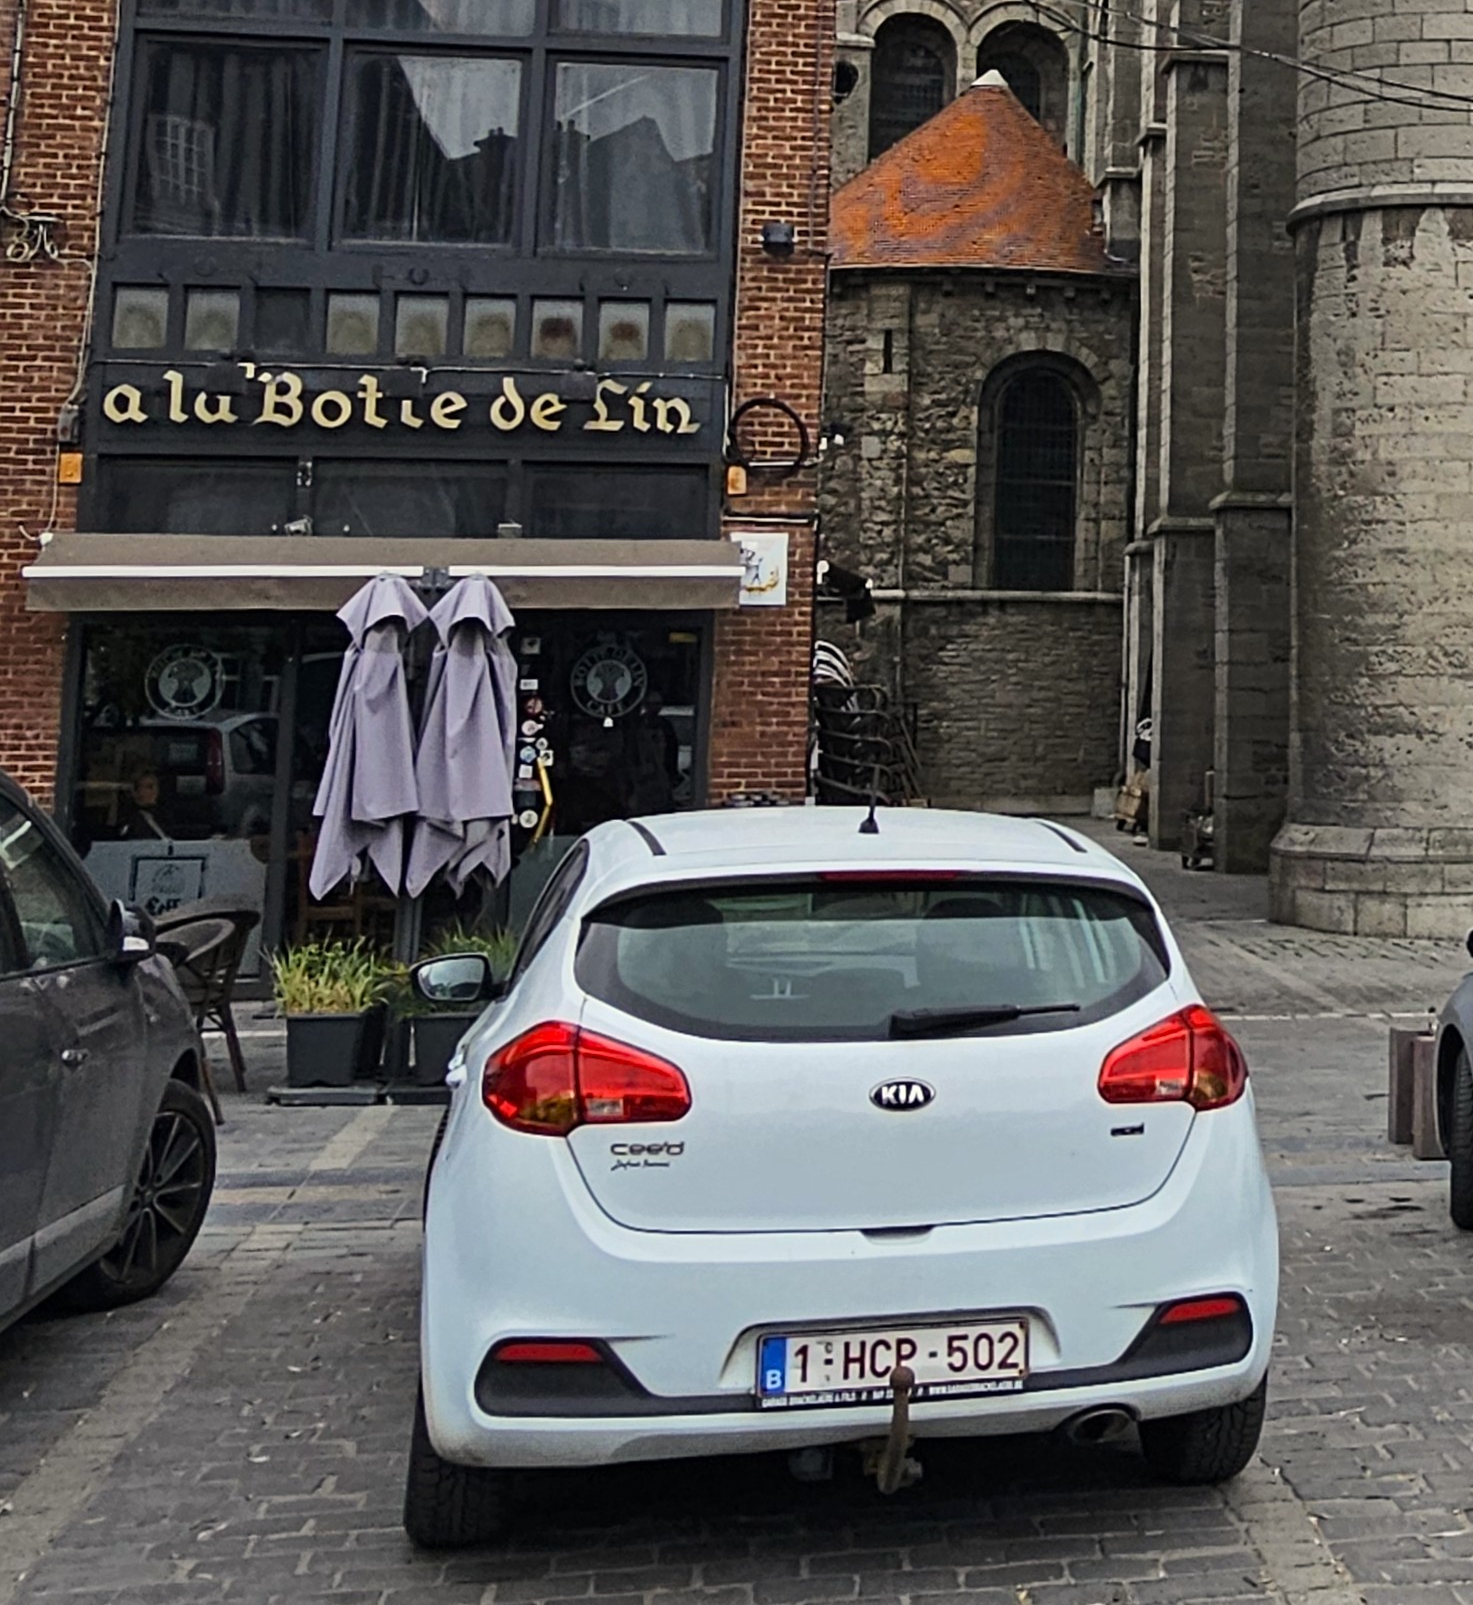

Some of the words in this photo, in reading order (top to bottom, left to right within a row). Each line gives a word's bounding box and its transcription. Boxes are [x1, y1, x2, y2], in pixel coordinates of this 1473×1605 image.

[103, 383, 148, 424] a
[490, 376, 567, 431] de
[881, 1084, 925, 1105] KIA
[766, 1369, 782, 1390] B
